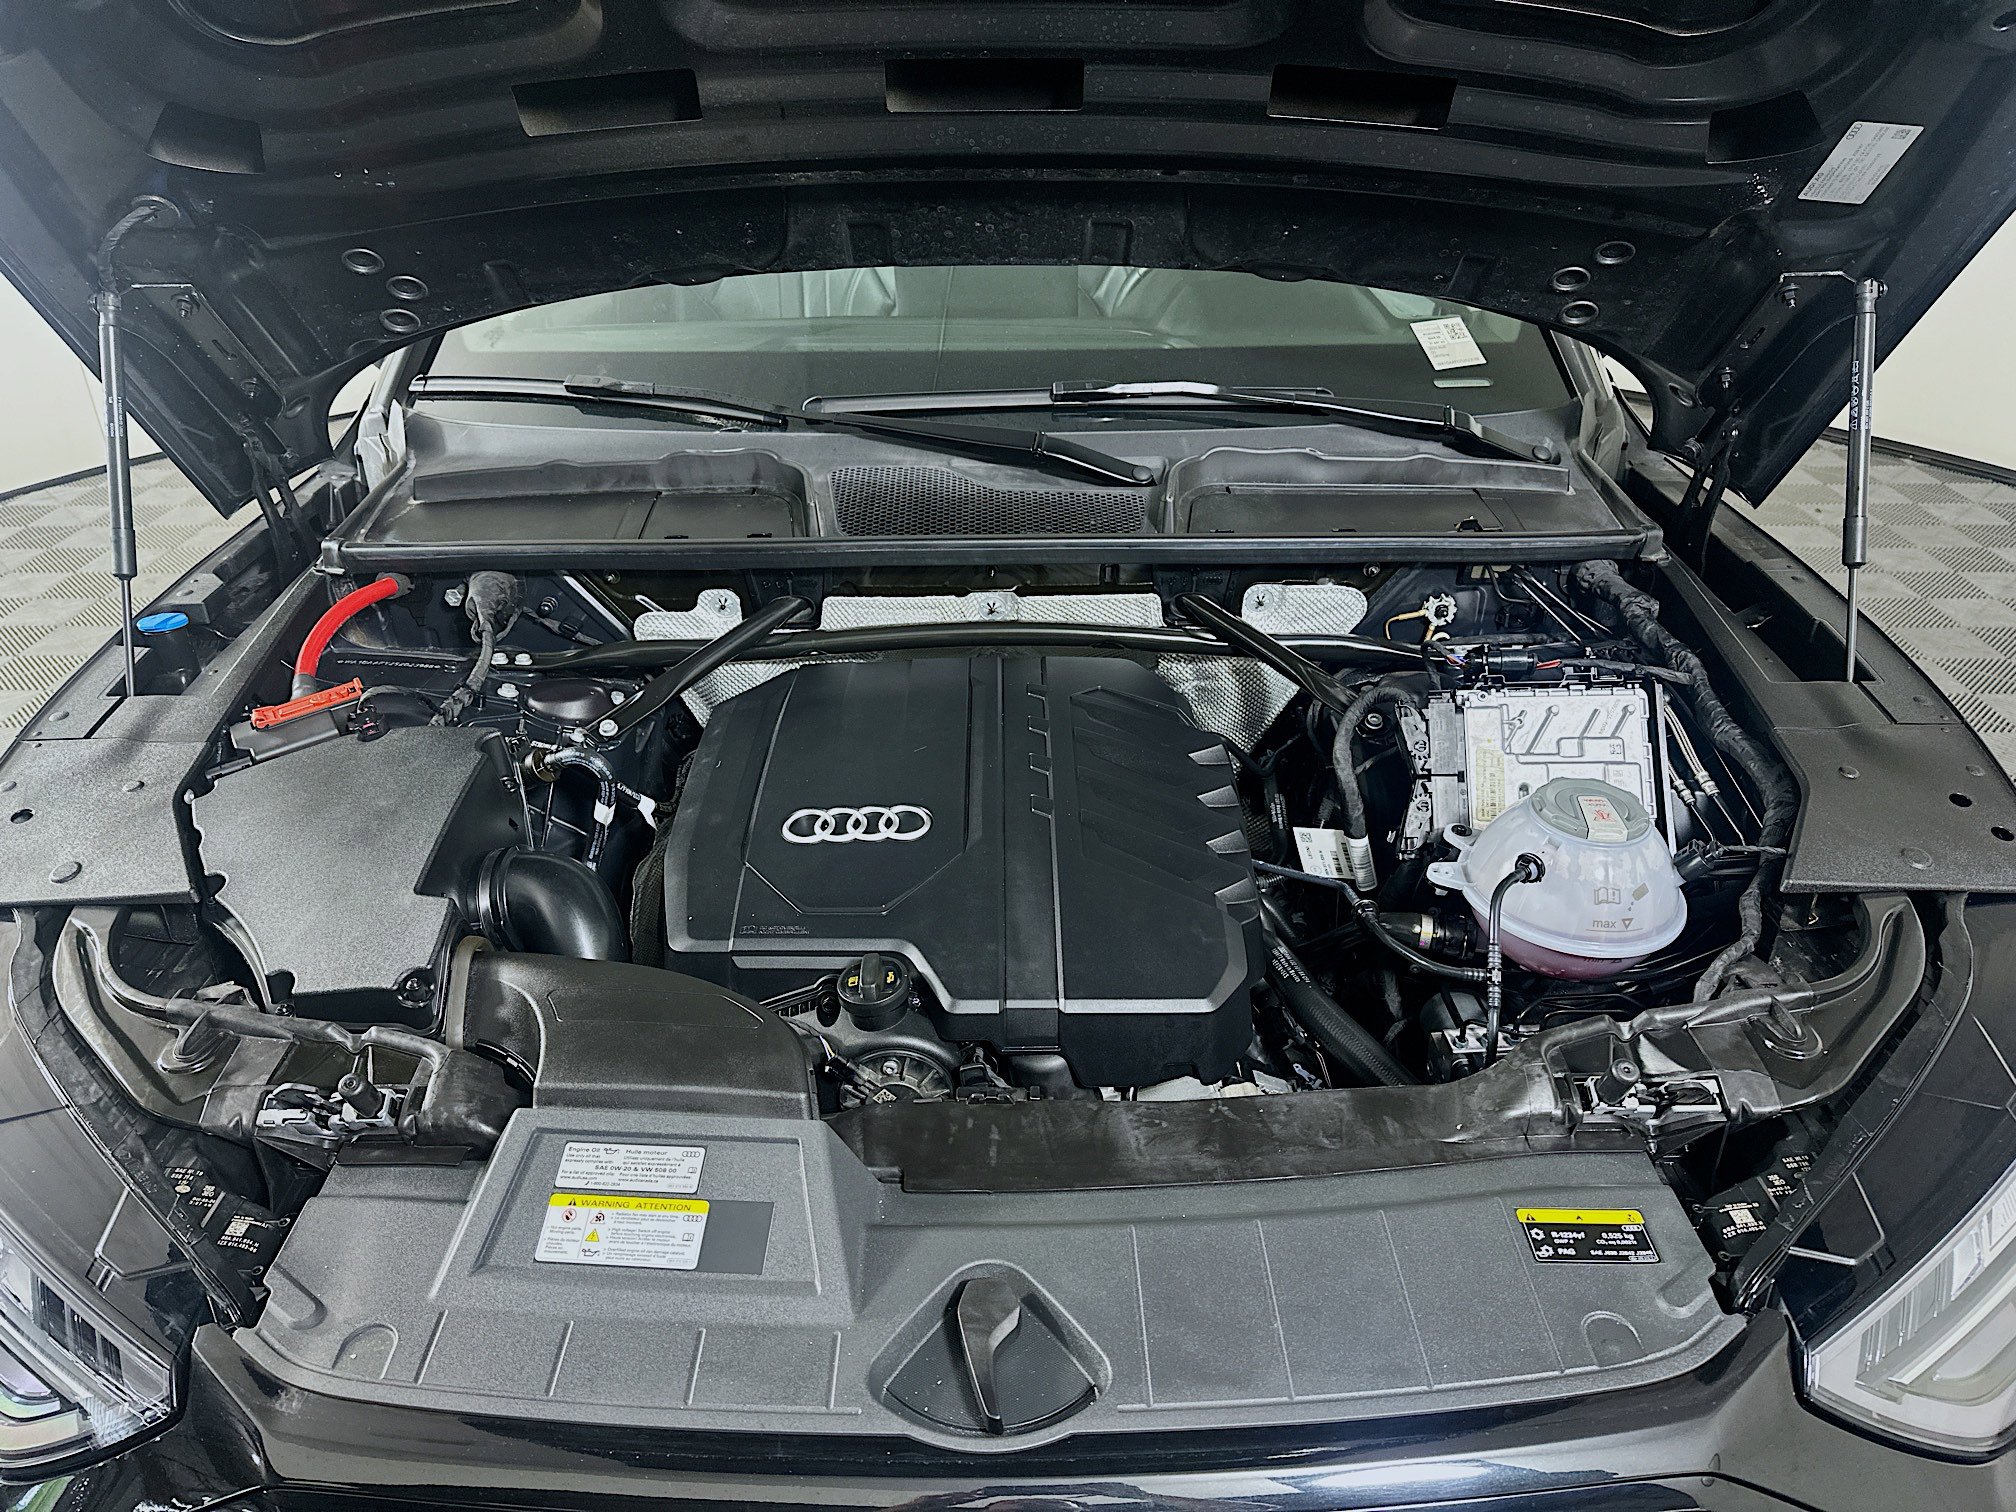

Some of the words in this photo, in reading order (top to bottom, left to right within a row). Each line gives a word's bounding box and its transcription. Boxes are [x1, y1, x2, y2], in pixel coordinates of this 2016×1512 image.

[1592, 919, 1617, 928] max
[580, 1199, 629, 1208] WARNING
[634, 1202, 691, 1211] ATTENTION
[1550, 1232, 1586, 1240] R-1234yf
[1624, 1232, 1634, 1240] kg
